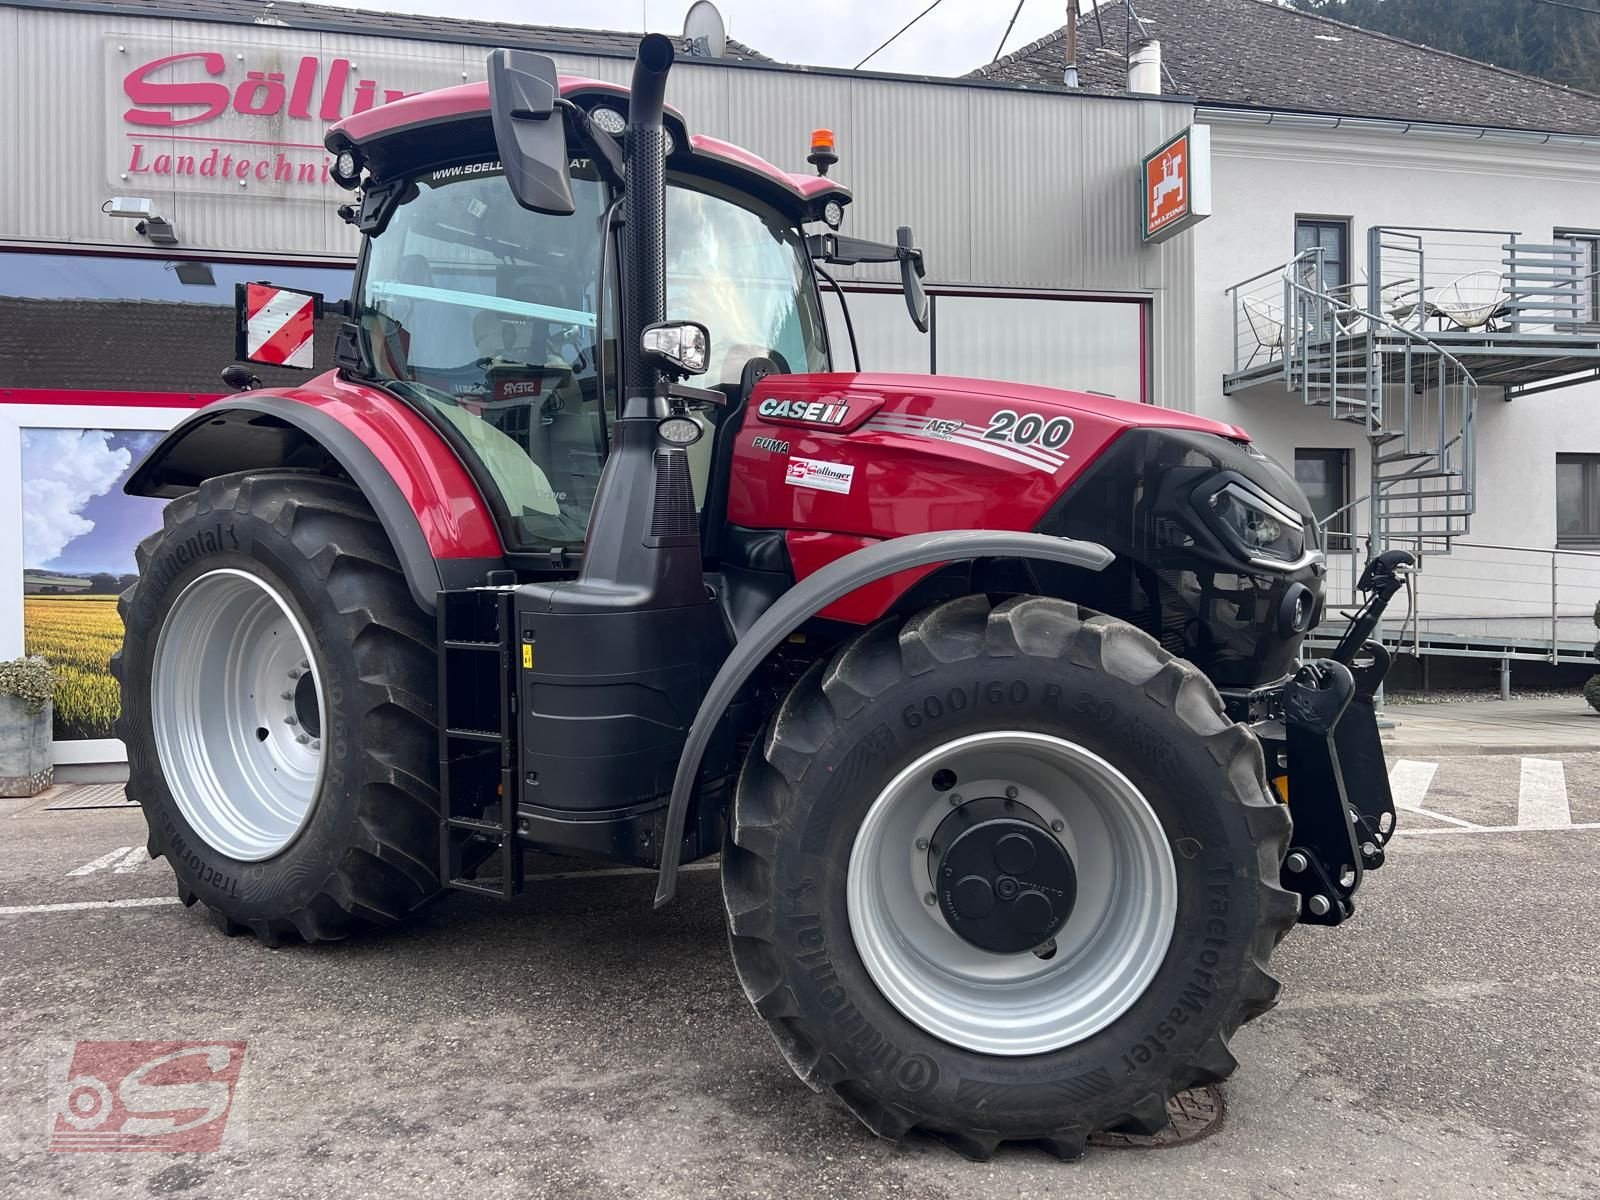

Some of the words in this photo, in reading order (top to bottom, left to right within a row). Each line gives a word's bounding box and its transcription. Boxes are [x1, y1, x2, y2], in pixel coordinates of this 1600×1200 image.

[1149, 203, 1185, 229] AMAZONE
[925, 419, 955, 434] AFS
[980, 409, 1074, 450] 200
[751, 436, 790, 454] PUMA
[902, 679, 1030, 729] 600/60
[1119, 861, 1235, 1077] TractorMaster
